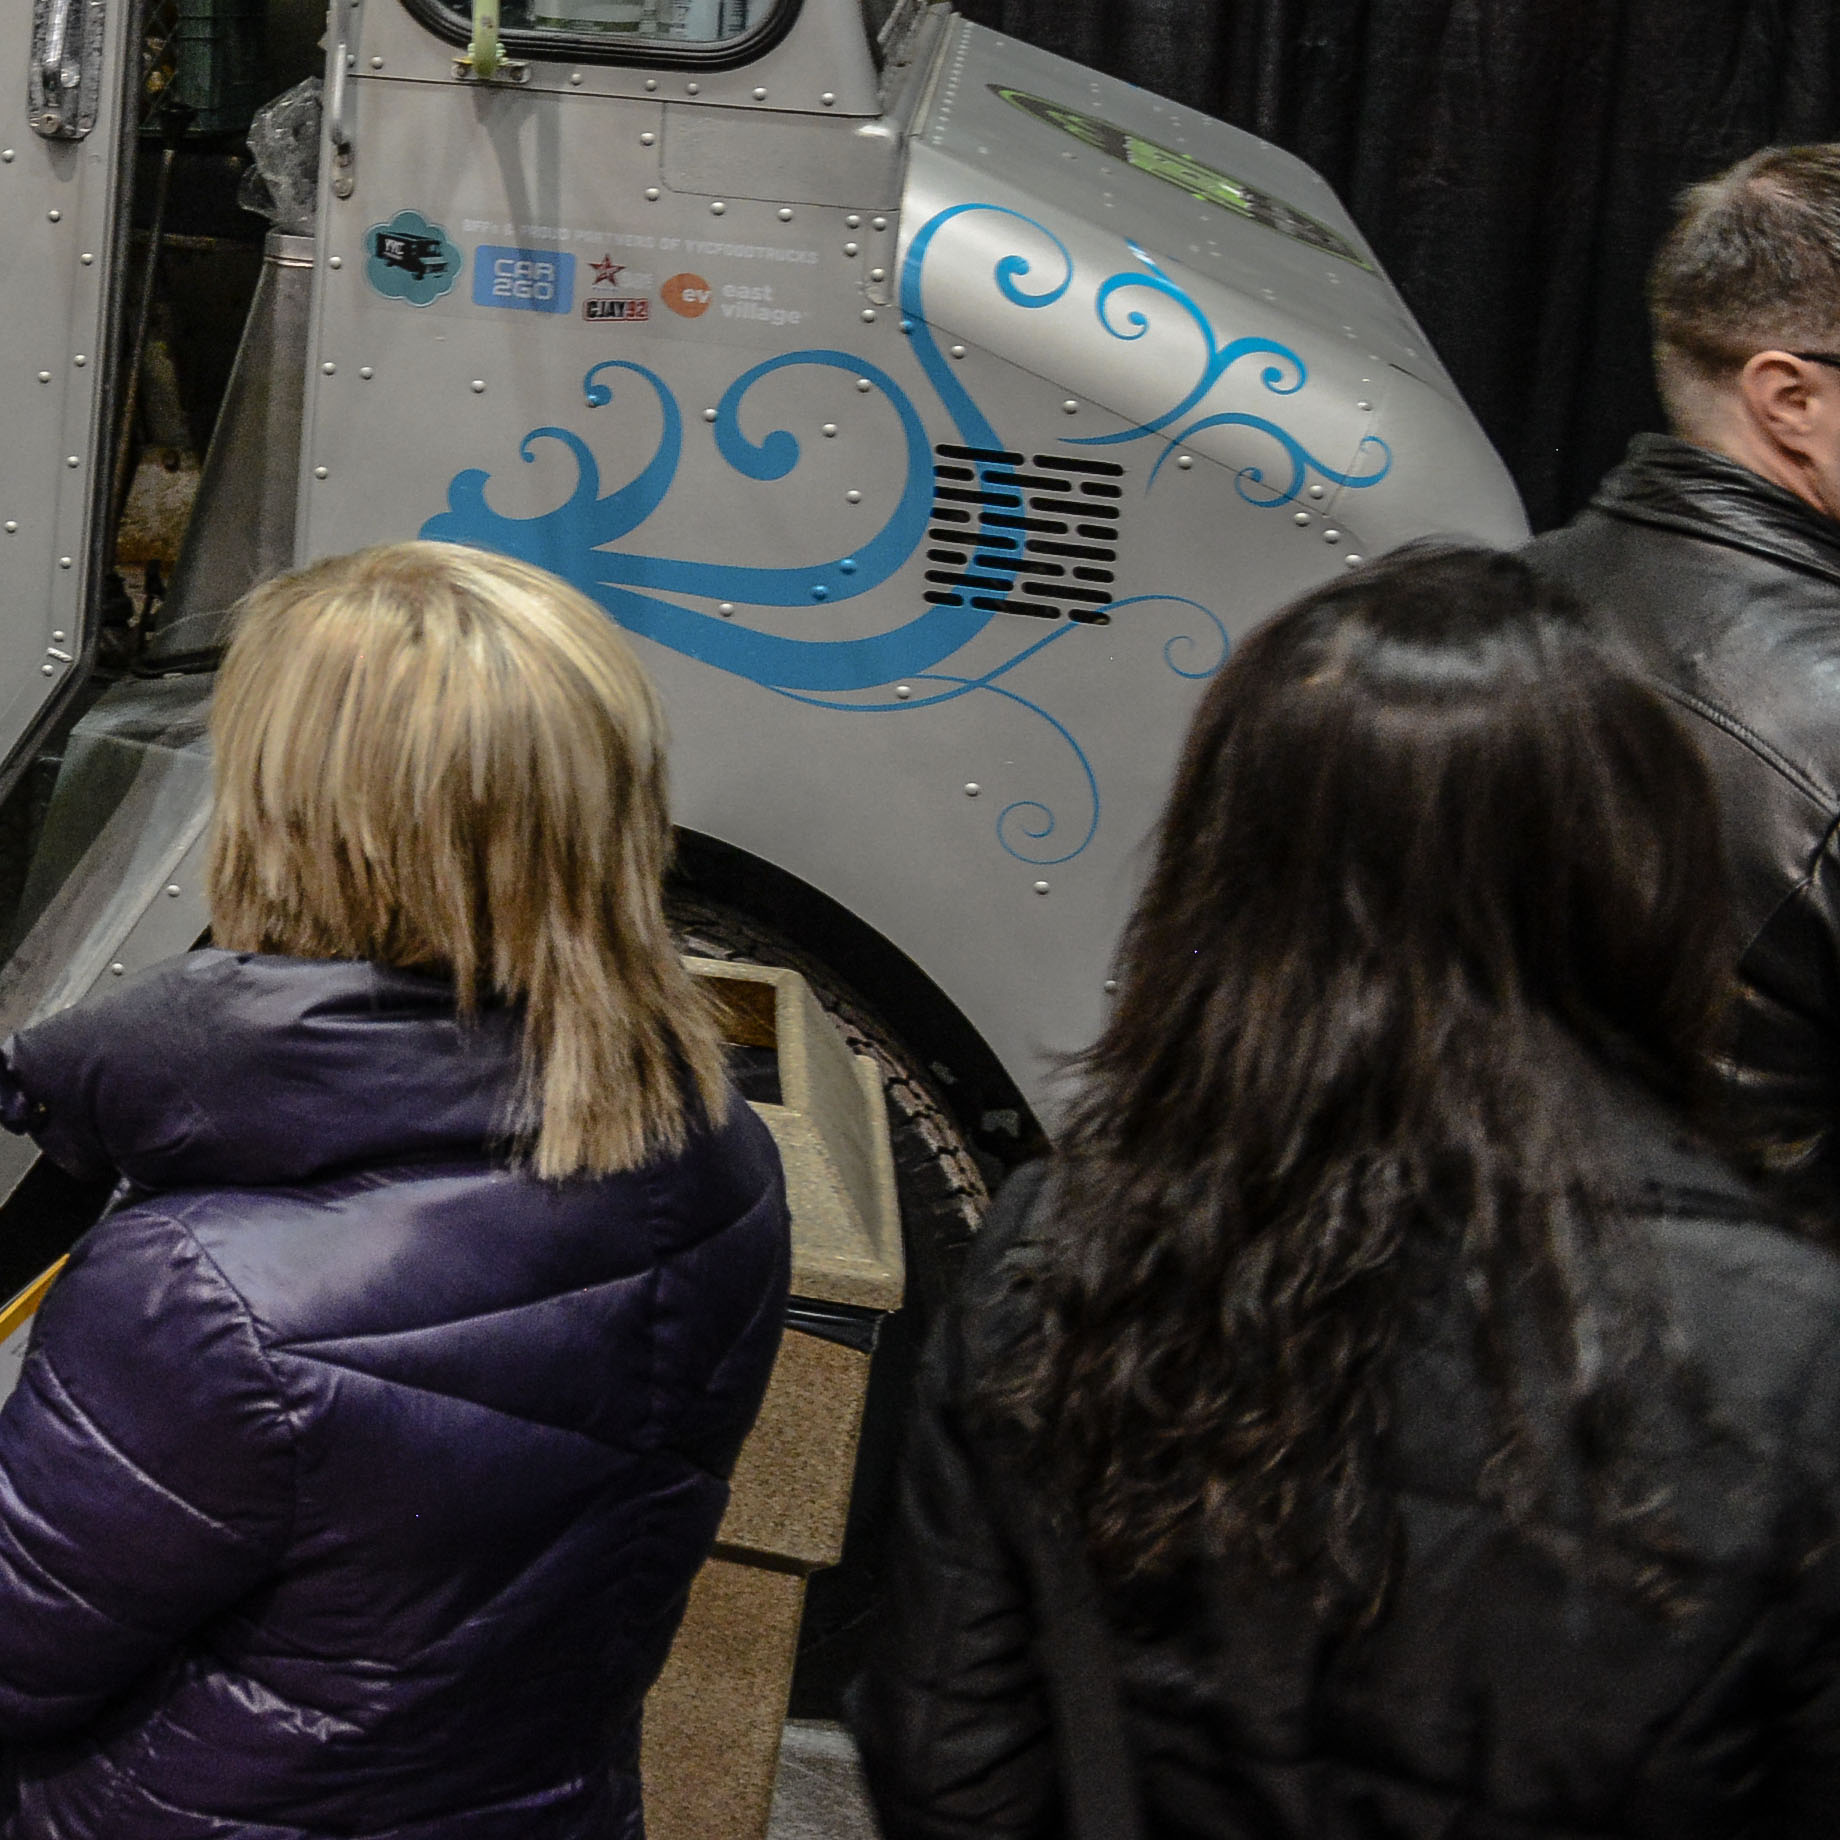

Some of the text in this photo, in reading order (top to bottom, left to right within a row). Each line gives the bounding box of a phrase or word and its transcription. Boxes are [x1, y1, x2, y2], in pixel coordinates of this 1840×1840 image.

[573, 228, 655, 249] PARTNERS
[659, 235, 682, 251] OF
[493, 258, 556, 281] CAR
[492, 281, 555, 301] 2GO
[681, 286, 711, 305] ev
[722, 282, 775, 302] east
[721, 301, 802, 326] village
